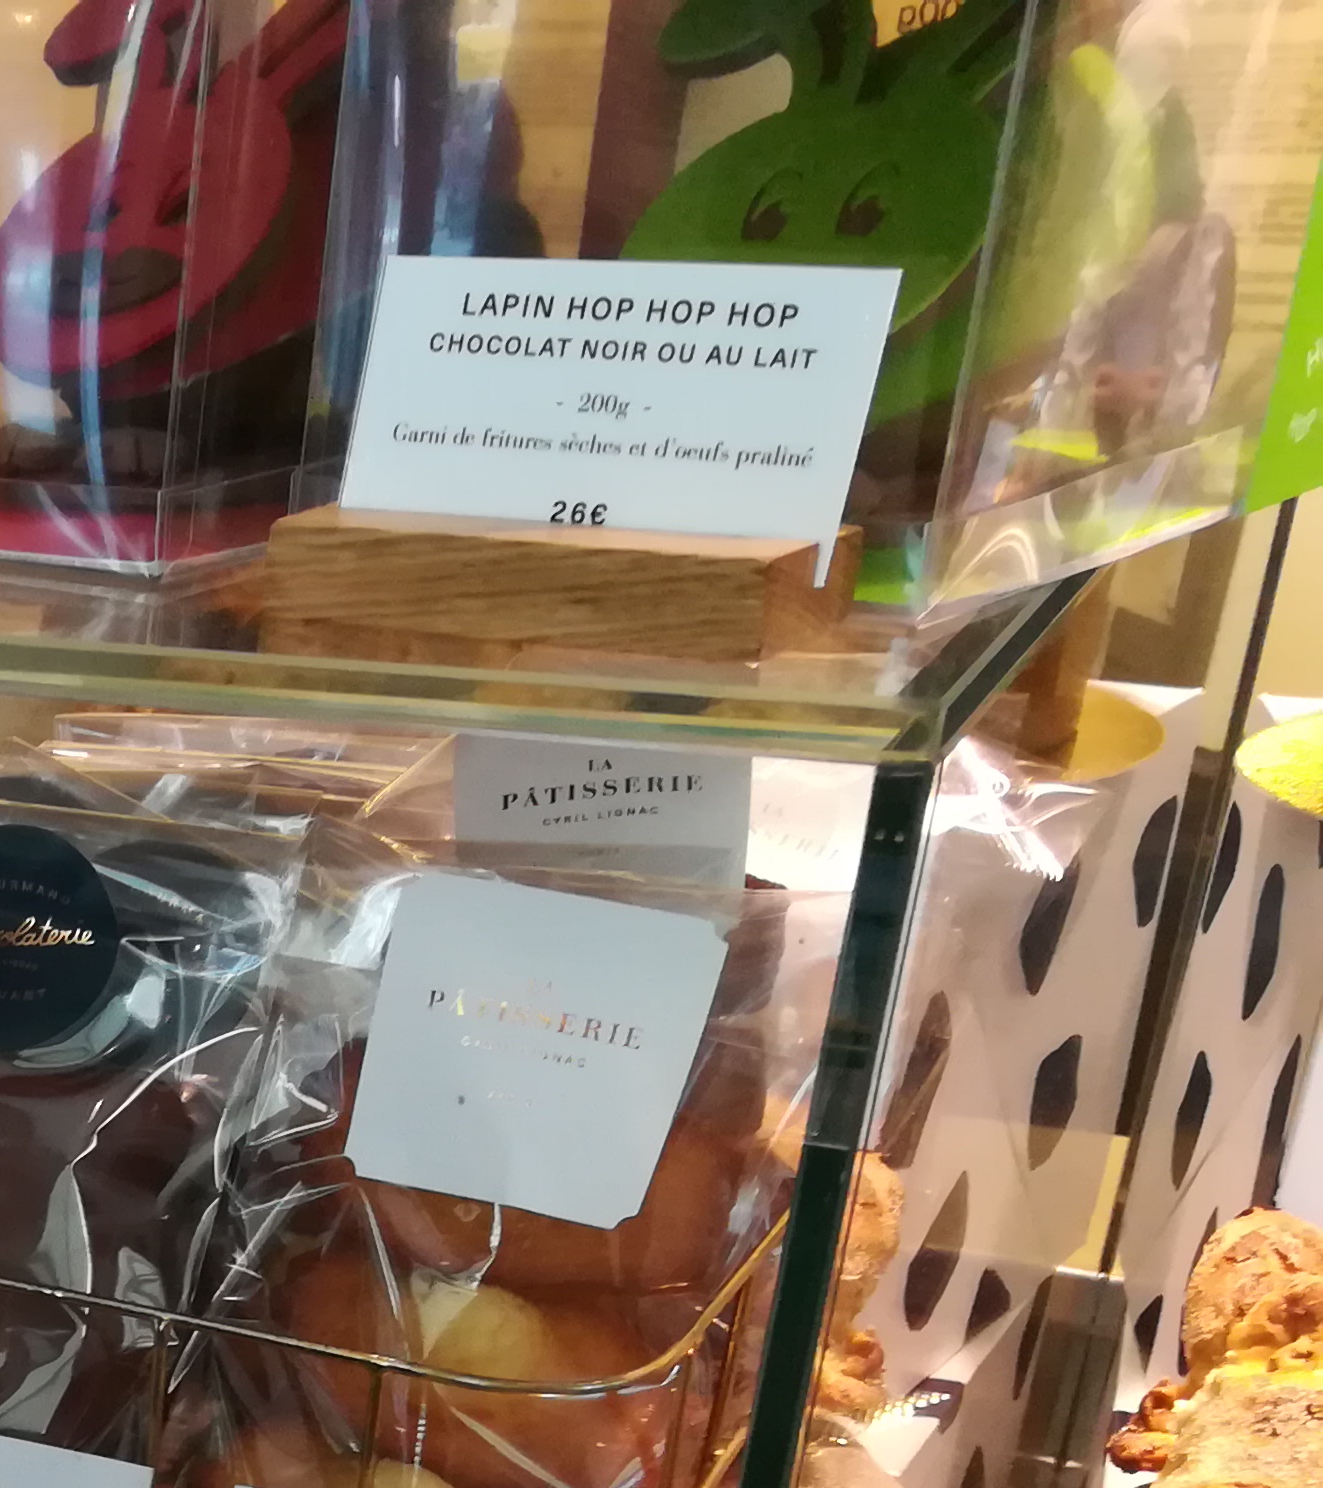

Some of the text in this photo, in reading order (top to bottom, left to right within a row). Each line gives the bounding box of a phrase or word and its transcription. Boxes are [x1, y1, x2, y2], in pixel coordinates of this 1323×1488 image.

[462, 292, 799, 328] LAPIN HOP HOP HOP
[429, 332, 818, 370] CHOCOLAT NOIR OU AU LAIT
[392, 421, 447, 445] Garni
[453, 426, 475, 446] de
[481, 427, 552, 451] fritures
[559, 431, 622, 456] sèches
[629, 438, 648, 457] et
[734, 446, 814, 470] praliné
[550, 500, 608, 526] 26€
[588, 759, 612, 772] LA
[501, 774, 703, 811] PÂTISSERIE
[542, 806, 659, 826] CYRIL LIGNAC
